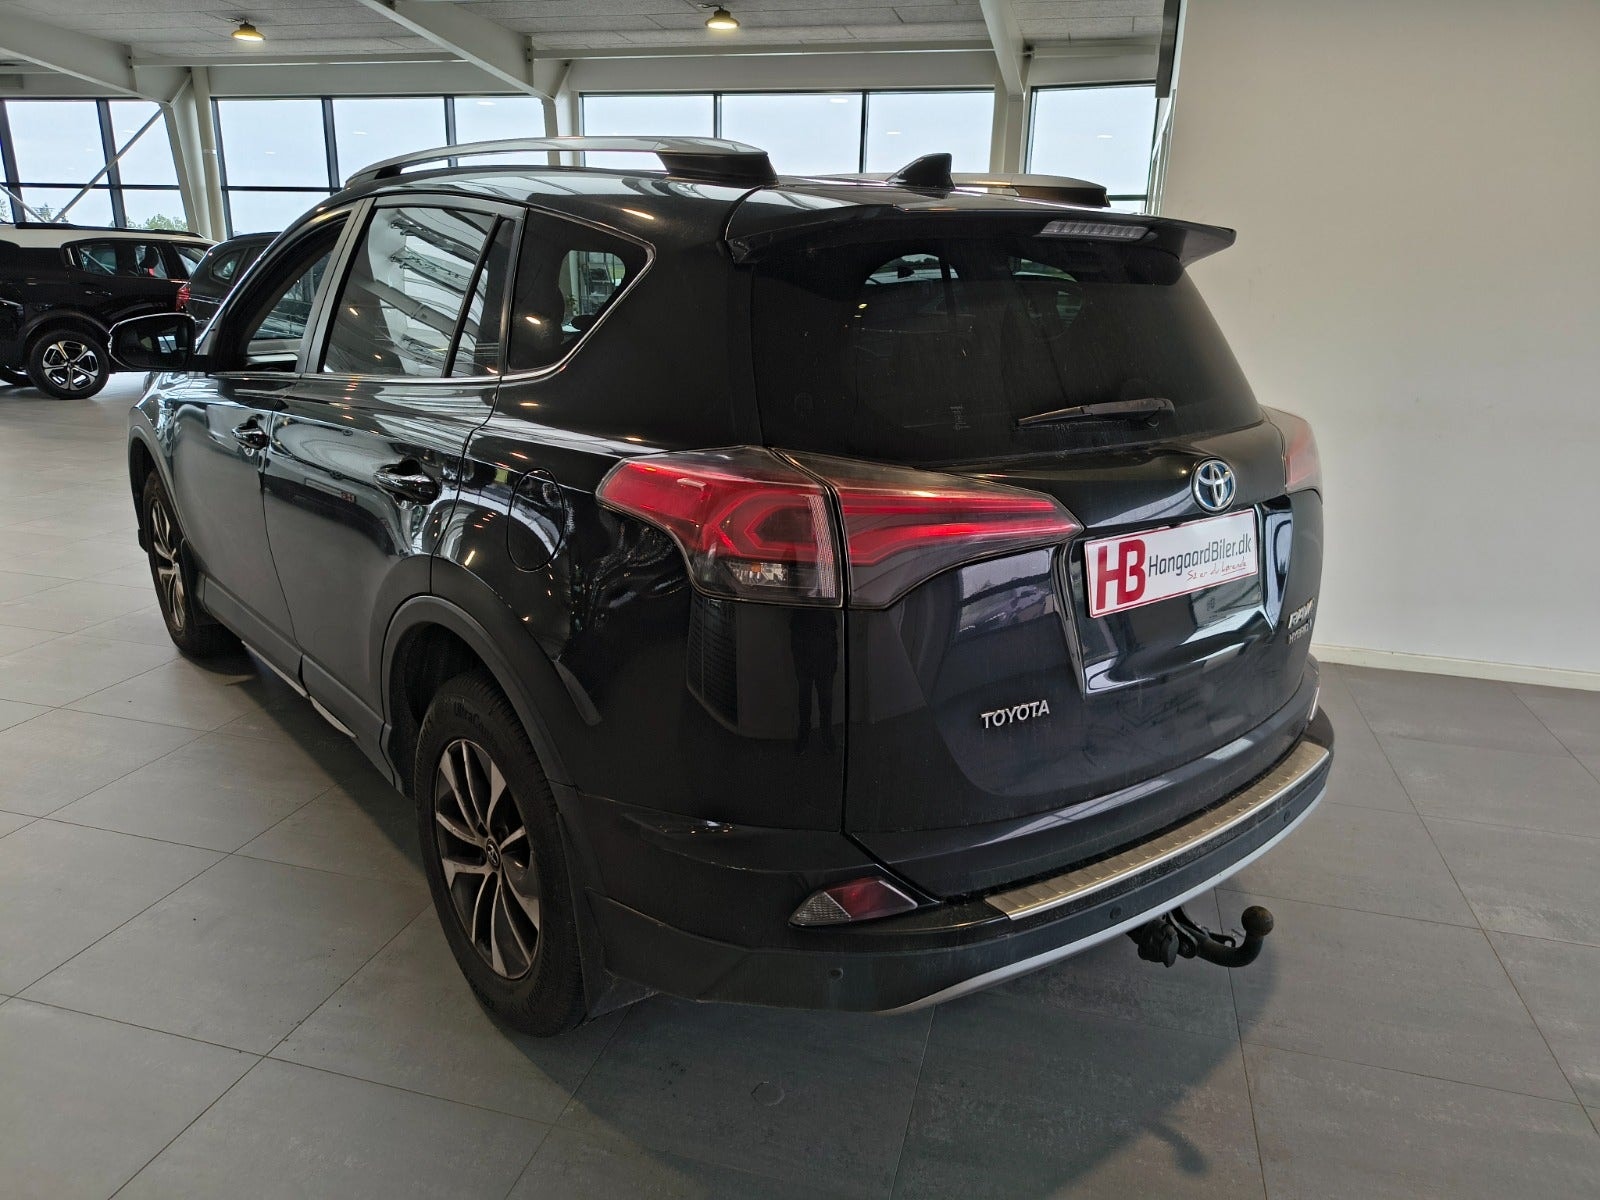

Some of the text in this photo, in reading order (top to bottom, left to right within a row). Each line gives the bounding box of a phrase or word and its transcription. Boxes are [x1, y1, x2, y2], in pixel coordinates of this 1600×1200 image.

[1096, 539, 1146, 610] HB
[1148, 533, 1251, 577] HangaardBiler.dk
[981, 700, 1050, 729] TOYOTA
